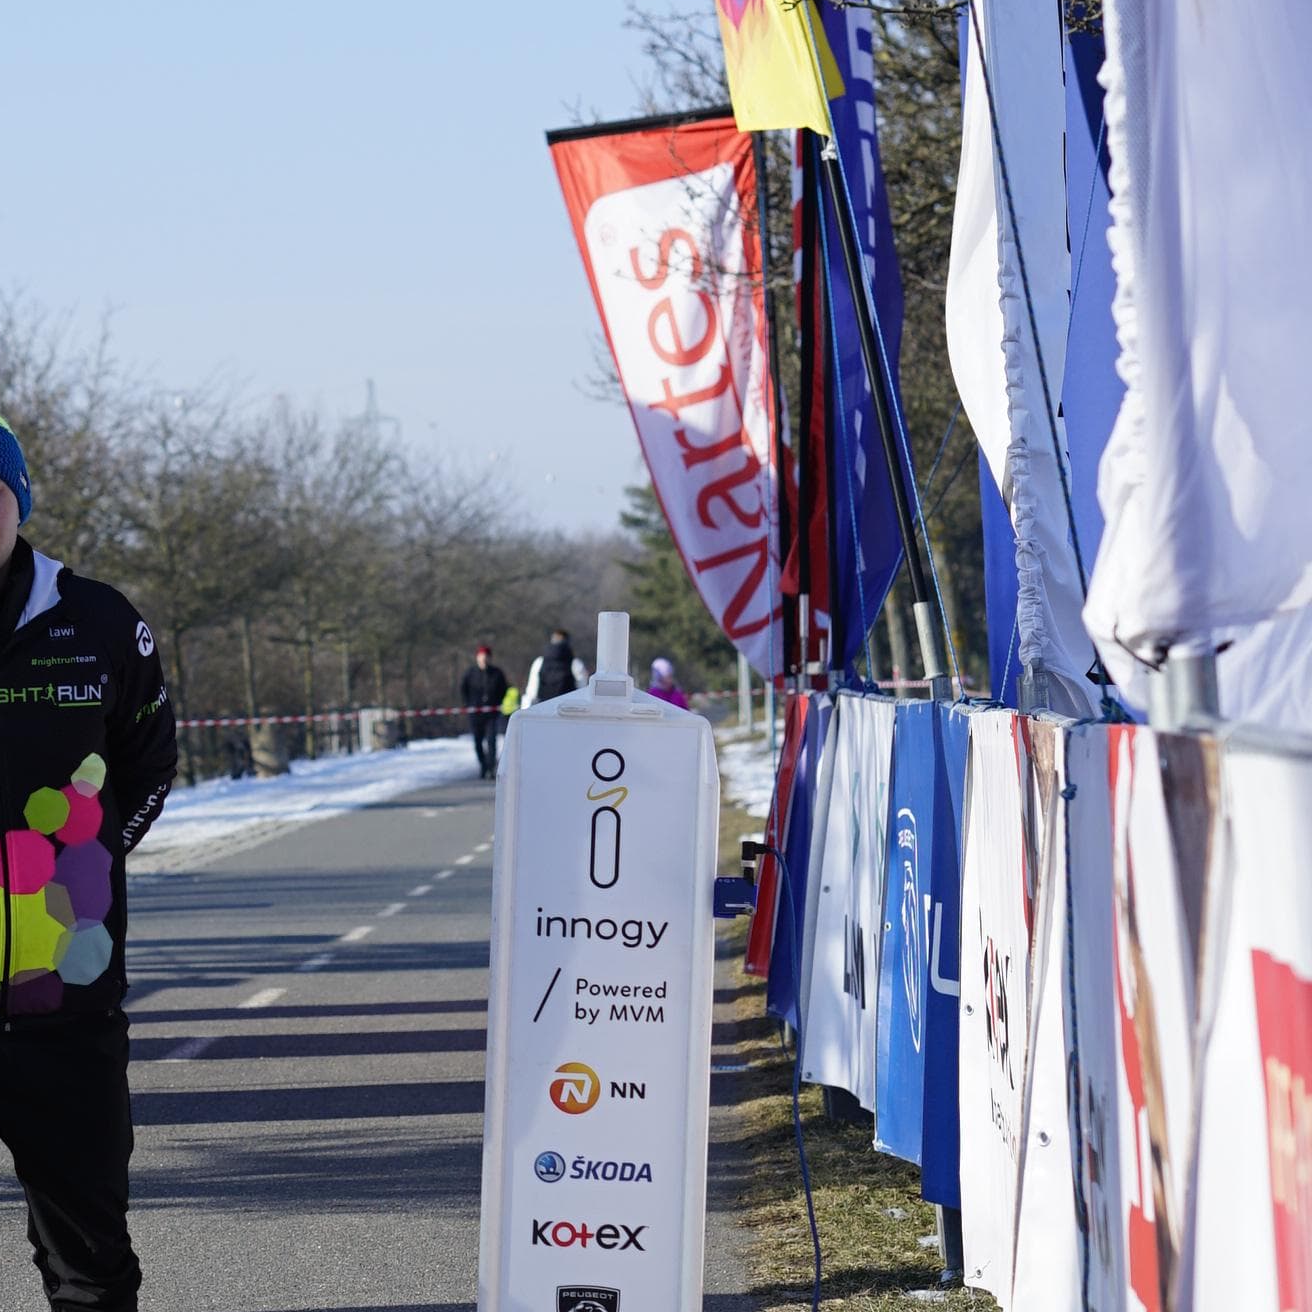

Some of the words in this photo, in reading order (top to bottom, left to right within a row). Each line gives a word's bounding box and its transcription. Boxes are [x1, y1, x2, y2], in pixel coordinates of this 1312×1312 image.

[49, 625, 75, 638] lawi
[31, 655, 97, 667] #nightrunteam
[536, 907, 669, 949] innogy
[575, 978, 667, 999] Powered
[575, 1002, 600, 1025] by
[609, 1004, 665, 1023] MVM
[610, 1081, 646, 1099] NN
[569, 1155, 653, 1182] ŠKODA
[562, 1291, 615, 1300] PEUGEOT
